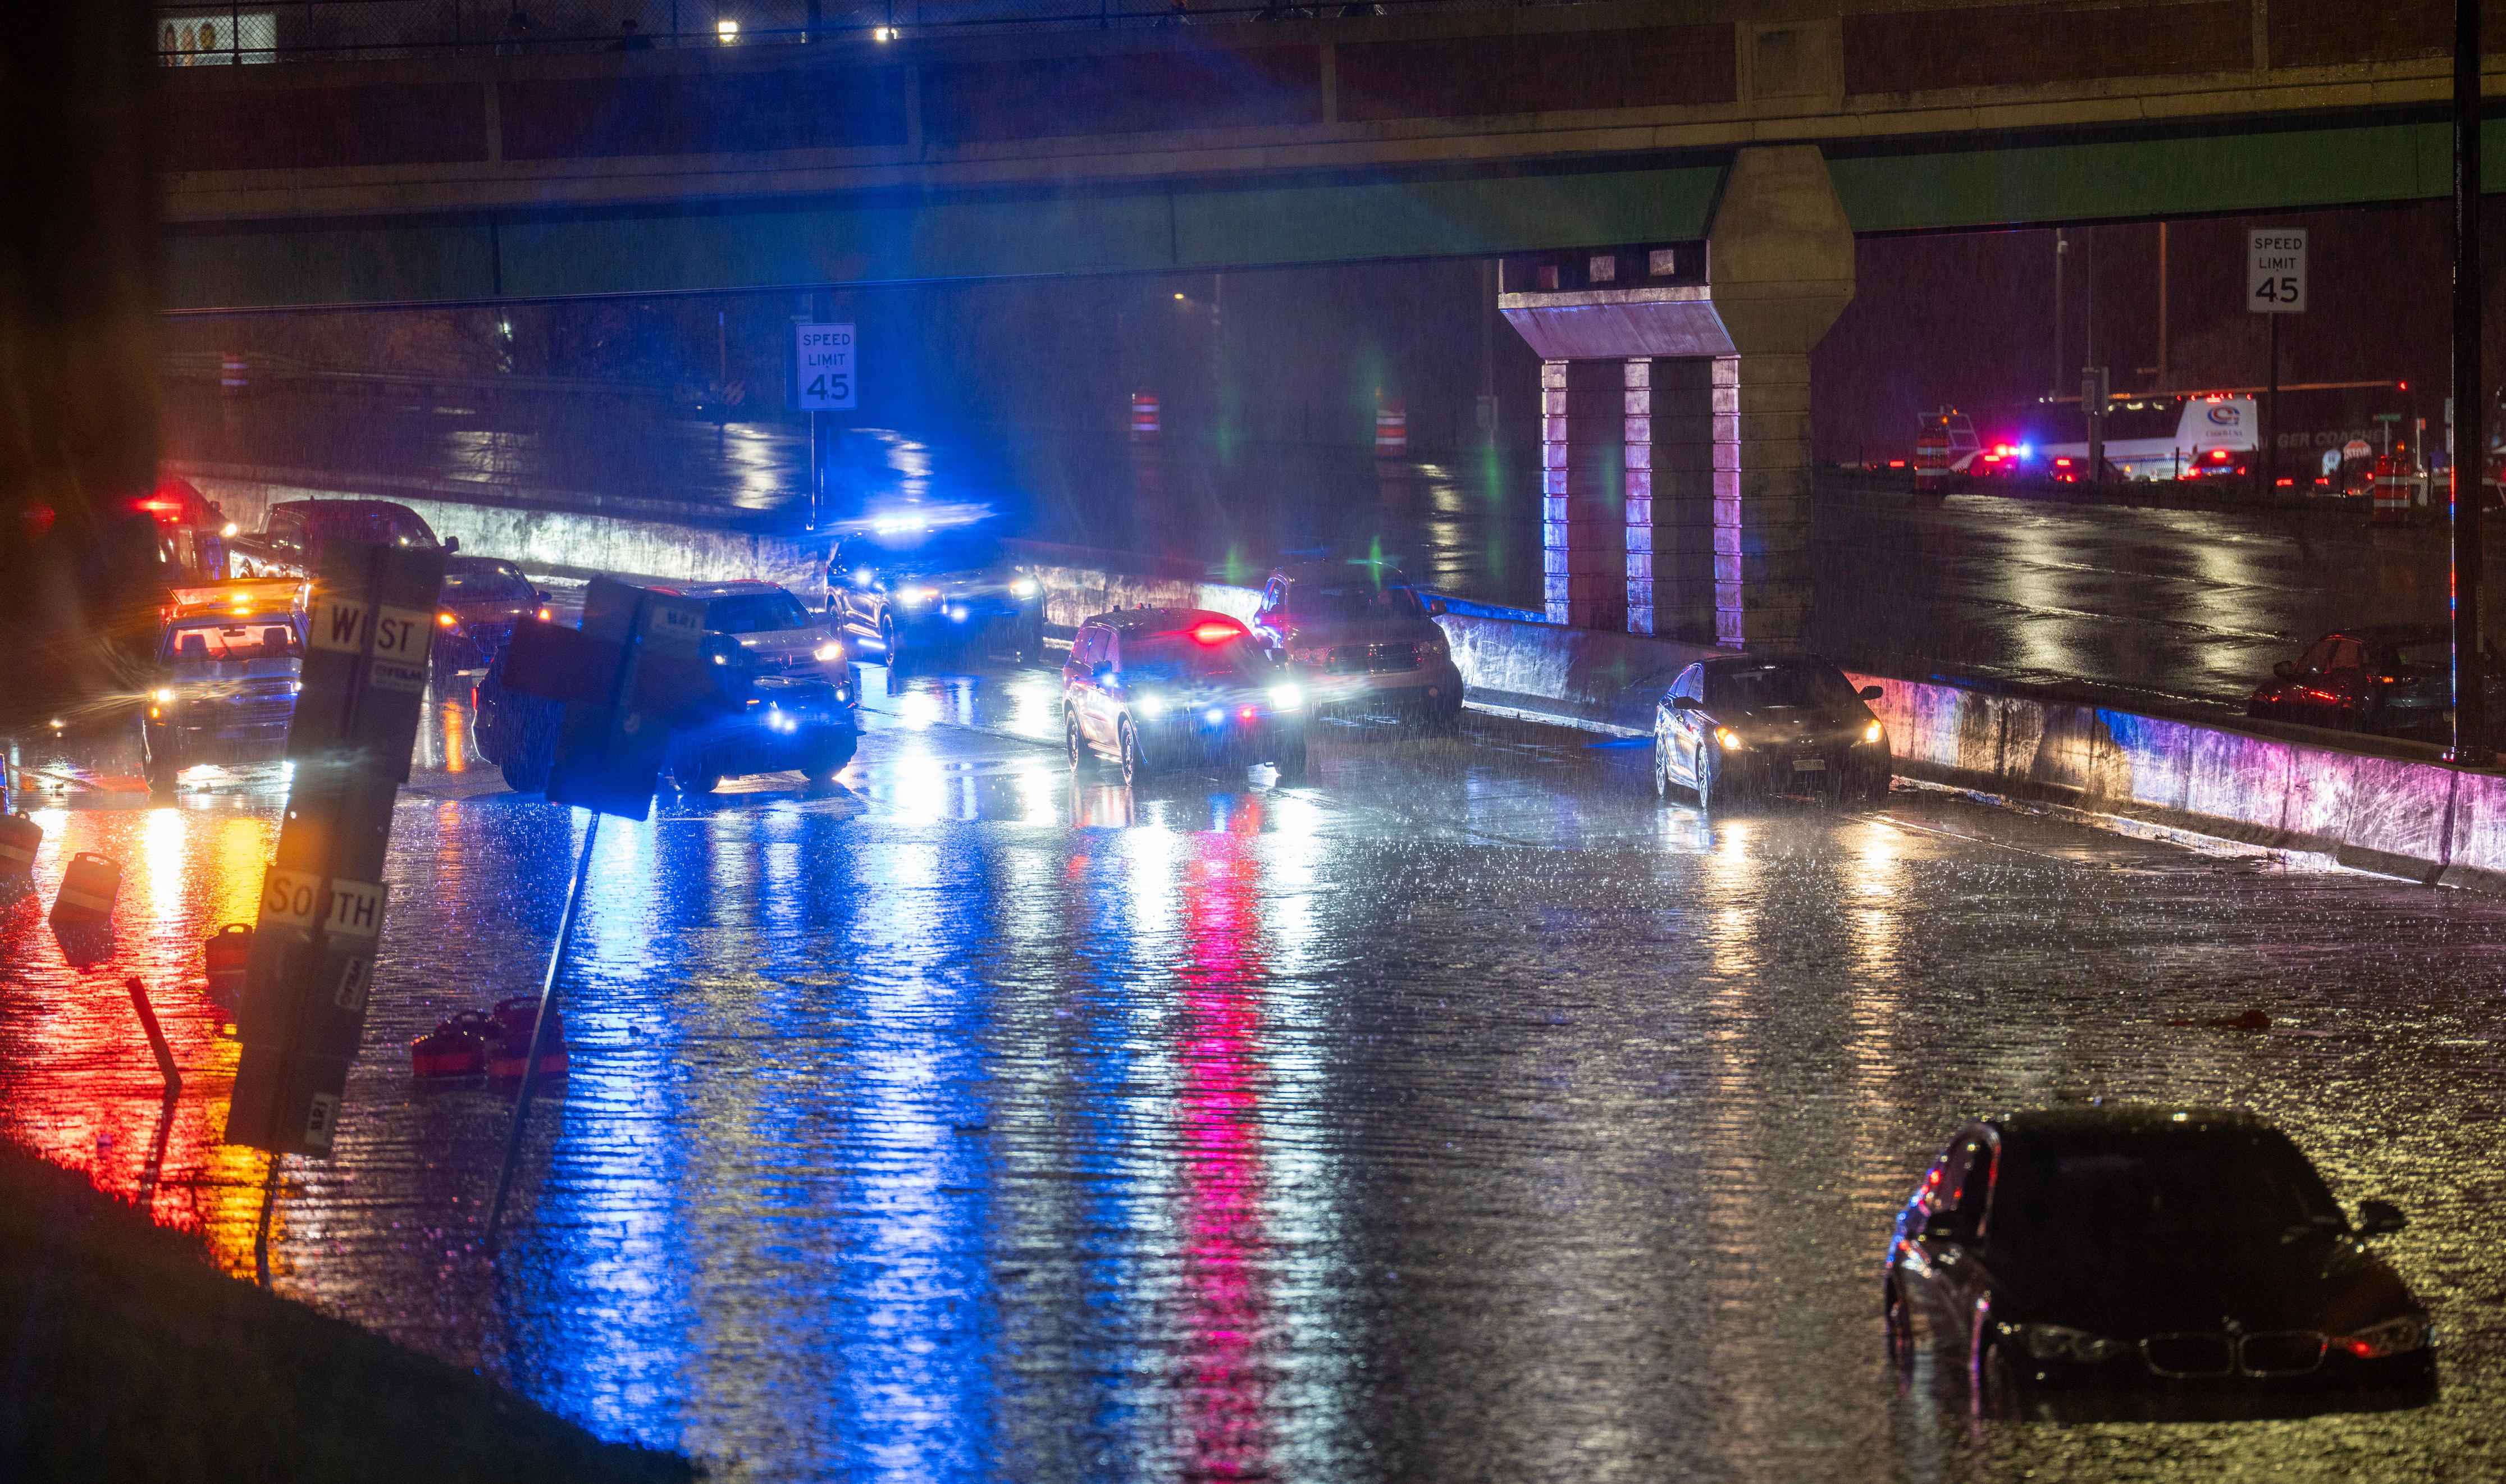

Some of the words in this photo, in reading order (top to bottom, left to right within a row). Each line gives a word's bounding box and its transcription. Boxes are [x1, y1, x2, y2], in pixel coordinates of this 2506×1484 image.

[2254, 238, 2302, 249] SPEED
[2259, 257, 2296, 269] LIMIT
[2256, 277, 2298, 303] 45
[803, 334, 851, 346] SPEED
[809, 354, 845, 366] LIMIT
[807, 374, 849, 400] 45
[332, 605, 414, 652] WST
[268, 876, 375, 927] SOTH
